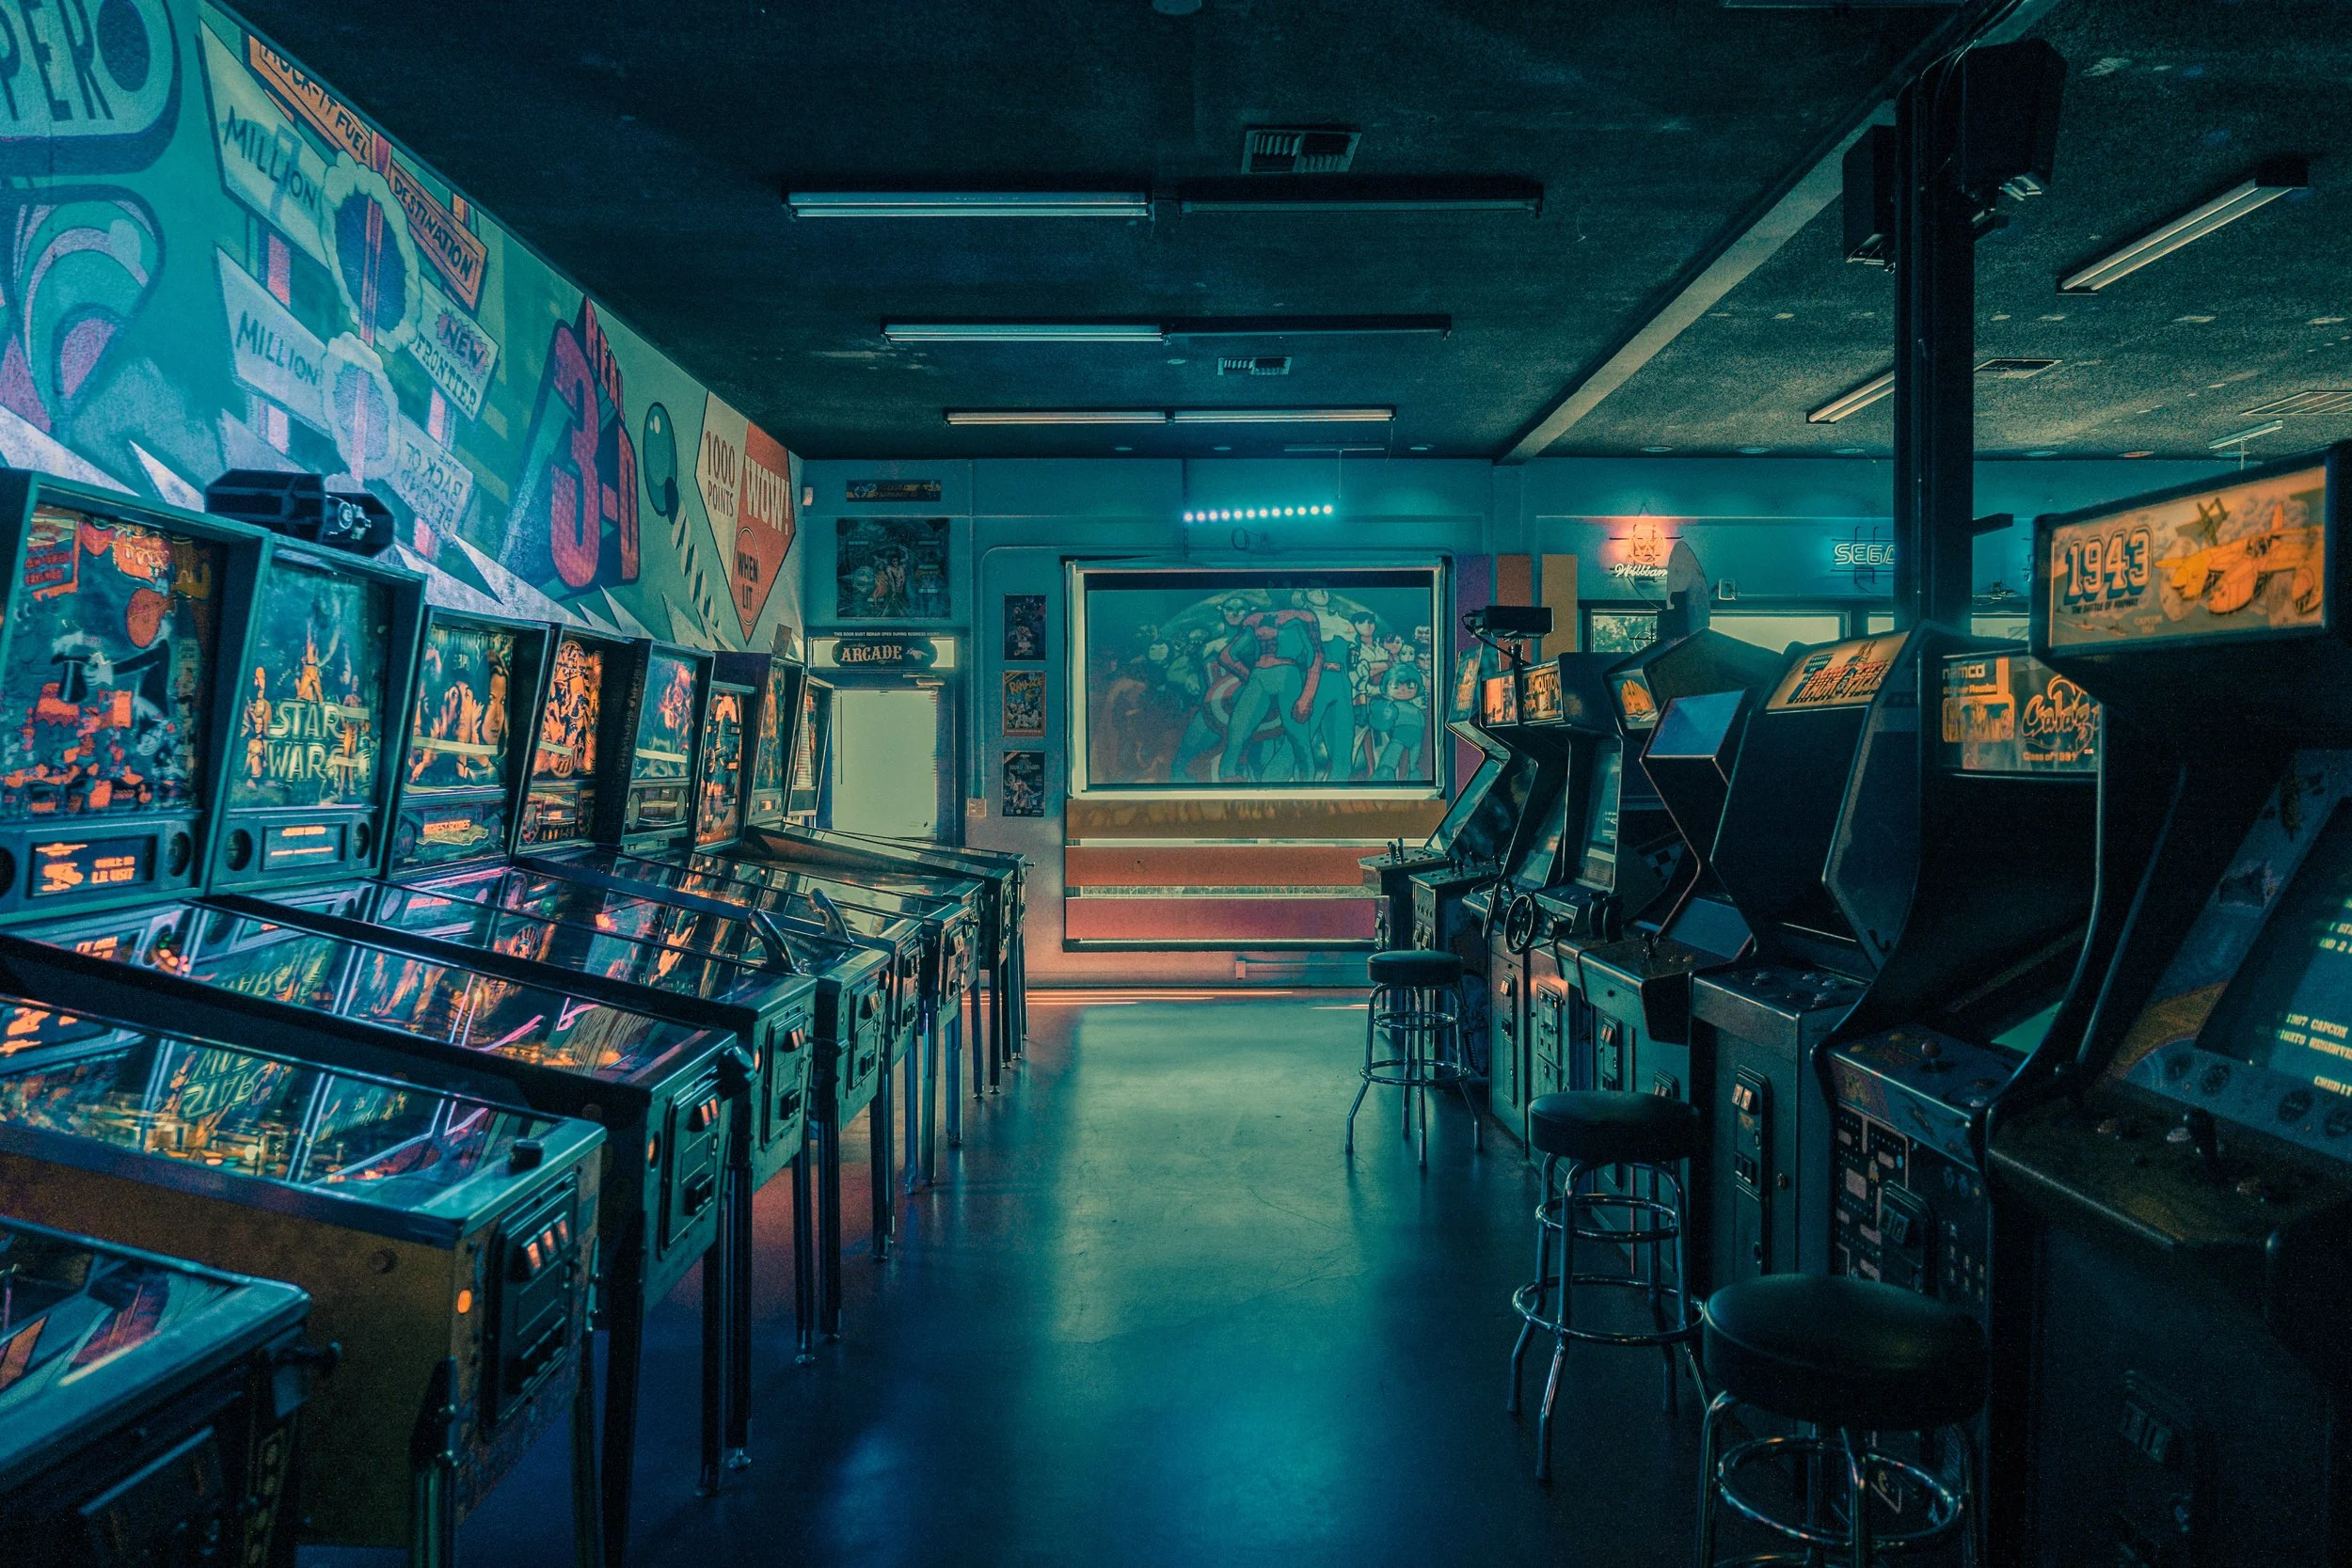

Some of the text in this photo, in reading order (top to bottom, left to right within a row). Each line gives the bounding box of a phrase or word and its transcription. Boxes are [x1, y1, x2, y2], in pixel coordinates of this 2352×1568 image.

[224, 105, 316, 213] MILLION
[336, 111, 368, 160] FUEL
[392, 175, 473, 281] DESTINATION
[237, 310, 319, 384] MILLION
[443, 320, 485, 368] NEW
[415, 331, 477, 417] FRONTIER
[706, 430, 736, 489] 1000
[707, 480, 734, 517] POINTS
[744, 454, 790, 536] WOW!
[738, 550, 759, 584] WHEN
[1834, 544, 1895, 565] SEGA
[2064, 524, 2153, 606] 1943
[741, 583, 754, 611] LIT
[840, 644, 903, 662] ARCADE
[268, 698, 346, 740] STAR
